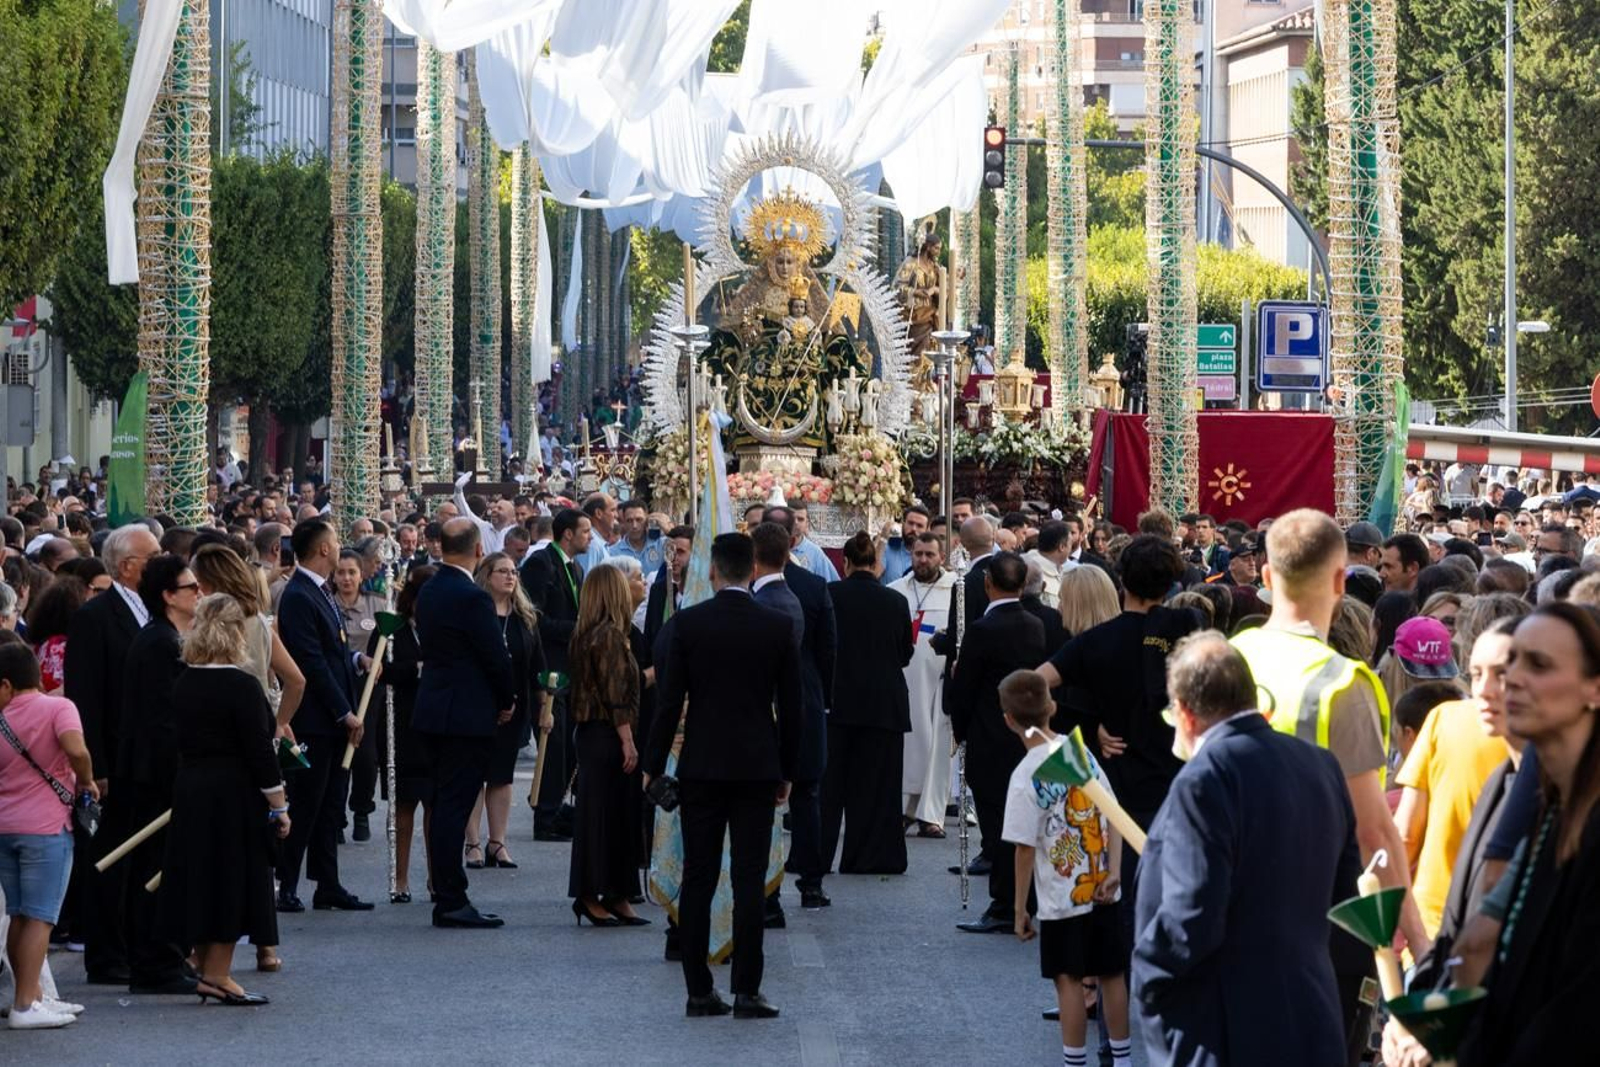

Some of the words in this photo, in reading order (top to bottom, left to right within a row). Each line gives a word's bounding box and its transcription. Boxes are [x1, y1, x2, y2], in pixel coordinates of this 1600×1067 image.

[1275, 313, 1313, 355] P
[1211, 353, 1233, 361] plaza
[1417, 640, 1442, 653] WTF
